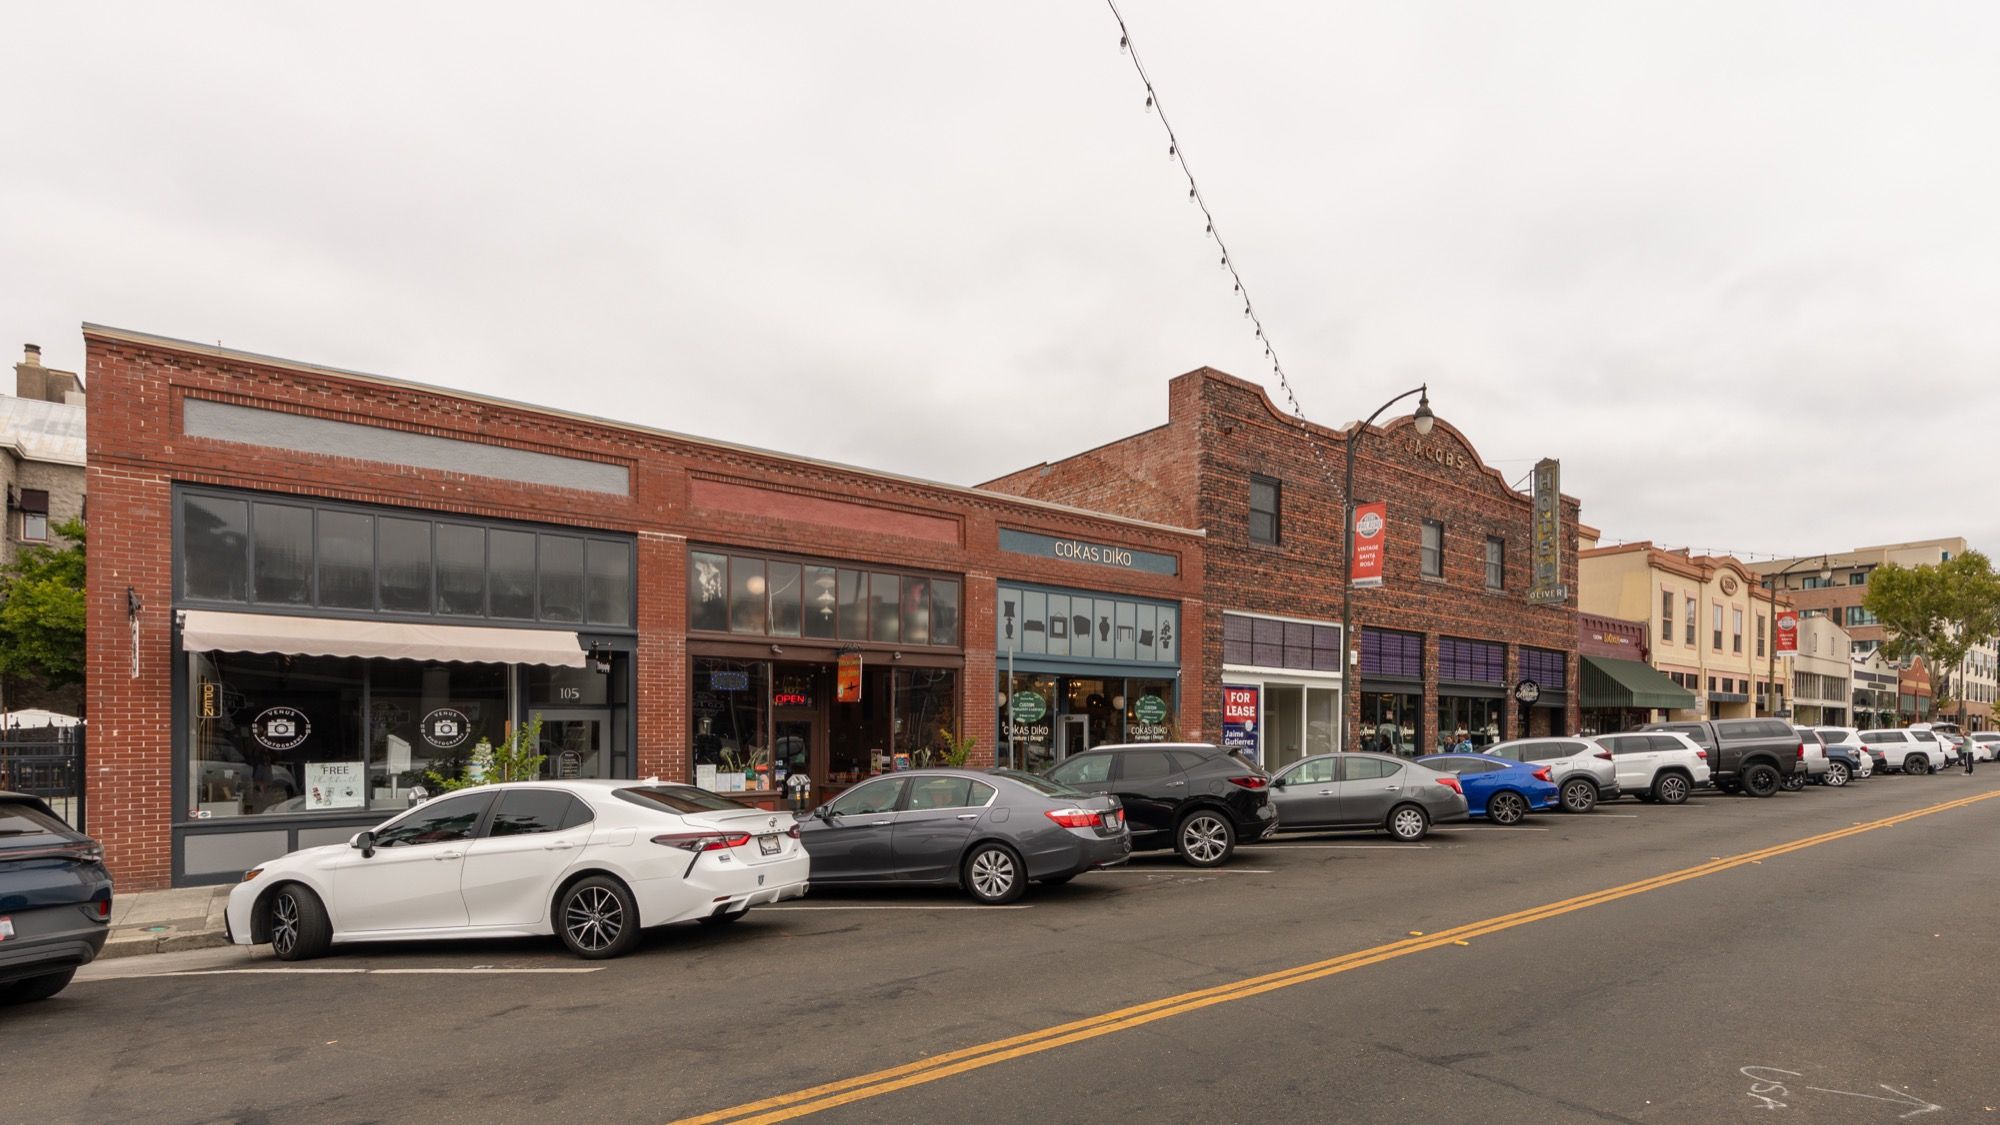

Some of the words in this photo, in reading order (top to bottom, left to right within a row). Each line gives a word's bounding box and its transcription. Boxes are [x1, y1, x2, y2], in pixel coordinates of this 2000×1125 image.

[1404, 439, 1464, 470] JACOBS
[1357, 544, 1379, 552] VINTAGE
[1359, 552, 1376, 560] SANTA
[1530, 588, 1563, 600] OLIVER
[560, 688, 580, 700] 105
[775, 694, 805, 704] OPEN
[1230, 692, 1250, 703] FOR
[204, 684, 214, 716] OPEN
[267, 709, 295, 717] VENUS
[1226, 705, 1255, 717] LEASE
[1003, 724, 1030, 735] CKAS
[1225, 730, 1244, 738] Jaime
[260, 734, 304, 749] PHOTOGRAPHY
[428, 733, 465, 746] PHOTOGRAPHY
[322, 766, 349, 775] FREE
